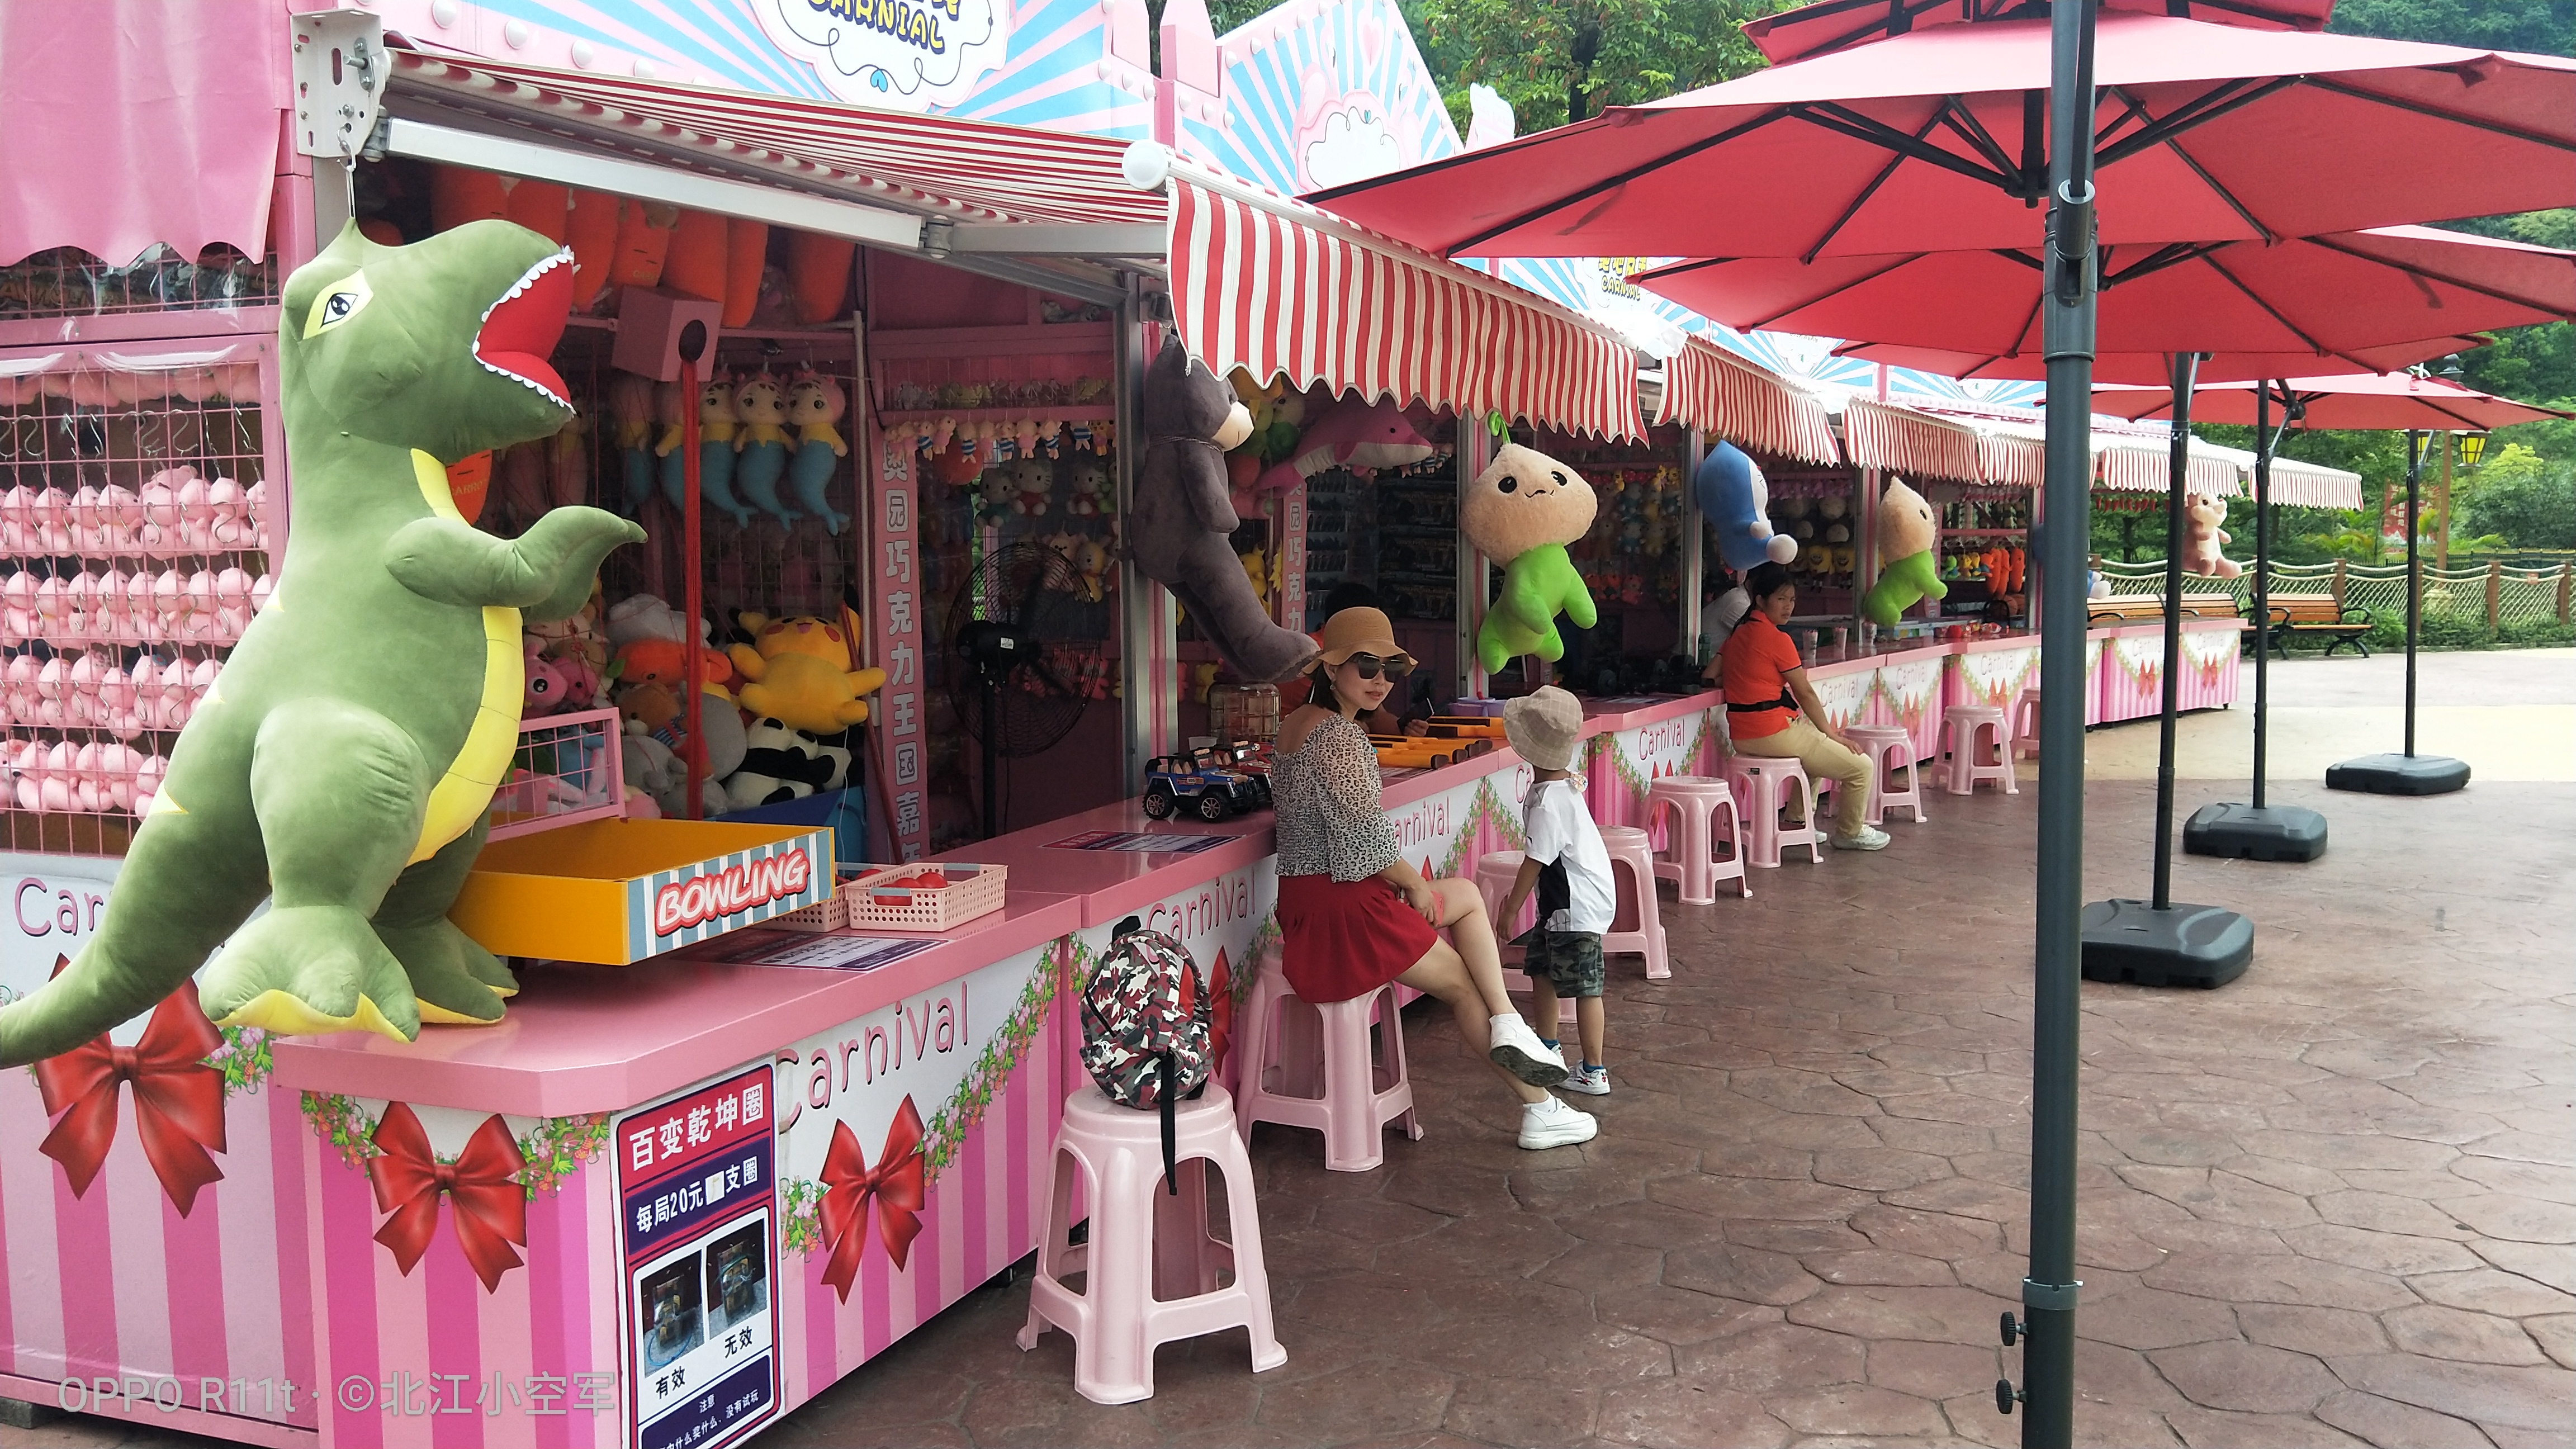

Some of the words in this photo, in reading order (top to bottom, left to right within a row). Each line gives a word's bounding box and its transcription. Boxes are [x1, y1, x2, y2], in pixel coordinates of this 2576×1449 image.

[807, 0, 945, 55] ARNIAL
[1820, 677, 1858, 707] Carnival
[1639, 718, 1684, 761] Carnival
[656, 849, 811, 935] BOWLING
[629, 1082, 764, 1171] 百变乾坤圈
[724, 1325, 753, 1358] 无效
[655, 1366, 685, 1399] 有效
[699, 1394, 716, 1414] 注意
